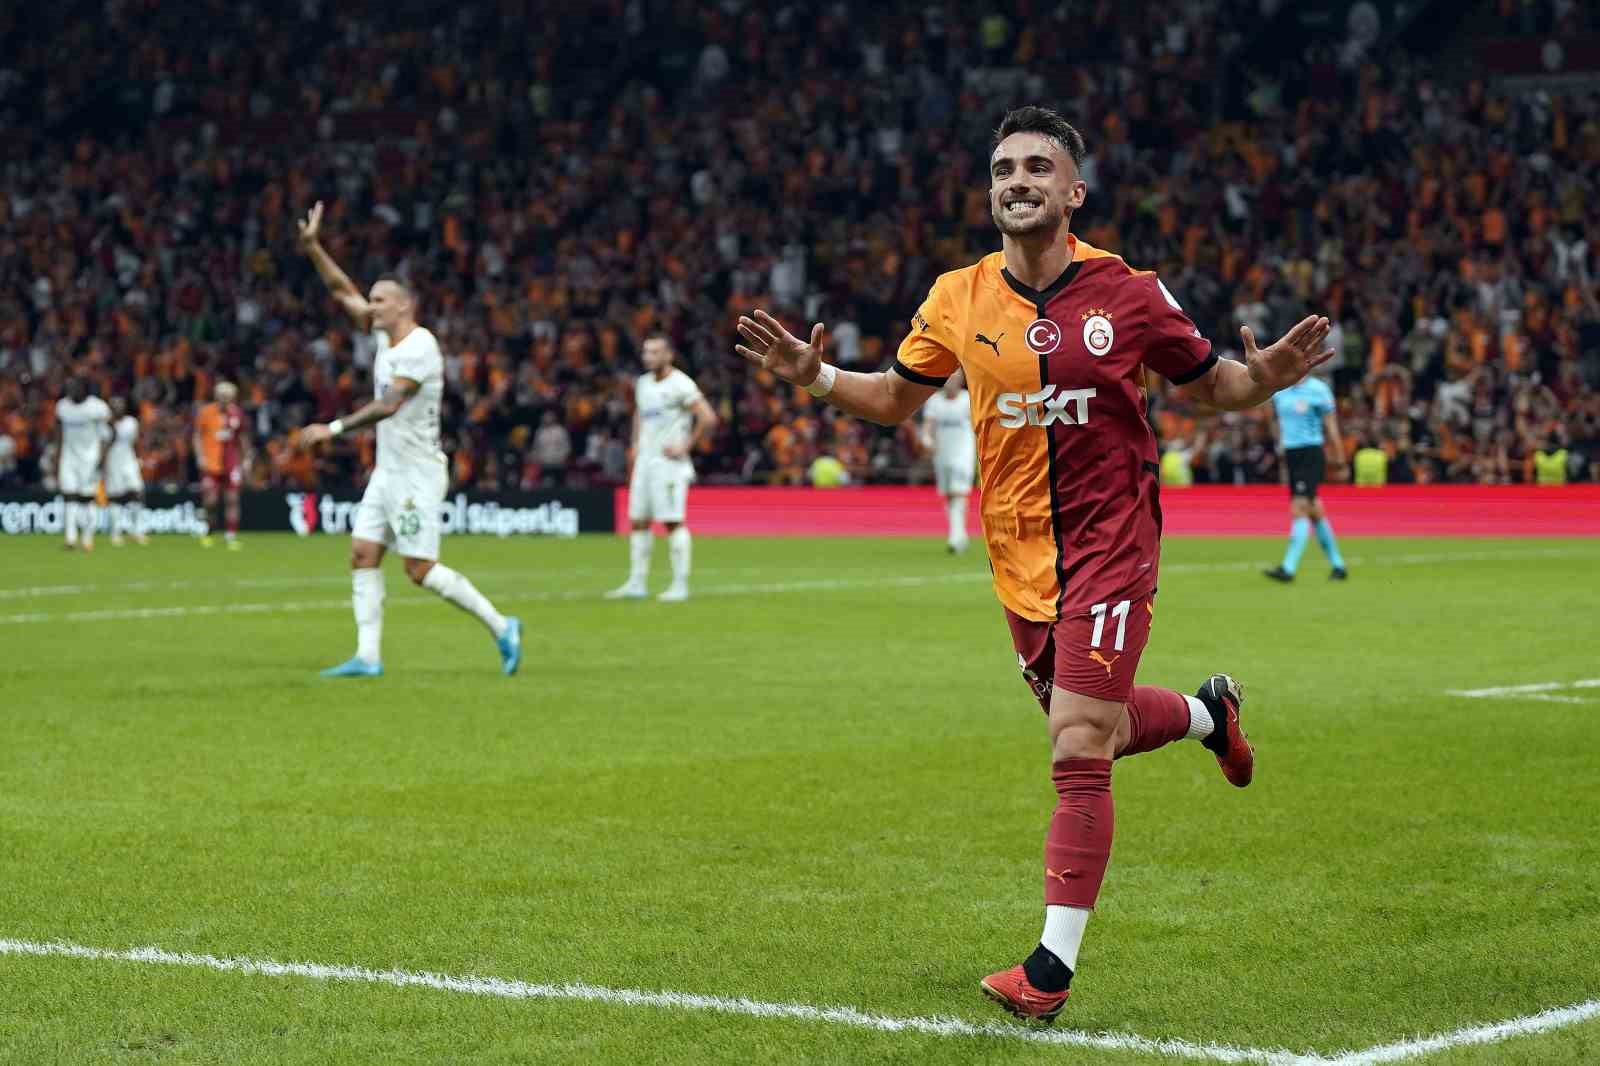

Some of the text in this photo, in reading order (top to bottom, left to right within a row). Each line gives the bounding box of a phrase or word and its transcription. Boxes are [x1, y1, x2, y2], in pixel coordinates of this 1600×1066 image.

[997, 384, 1097, 428] SIXT
[320, 494, 467, 533] trol
[1090, 600, 1130, 651] 11
